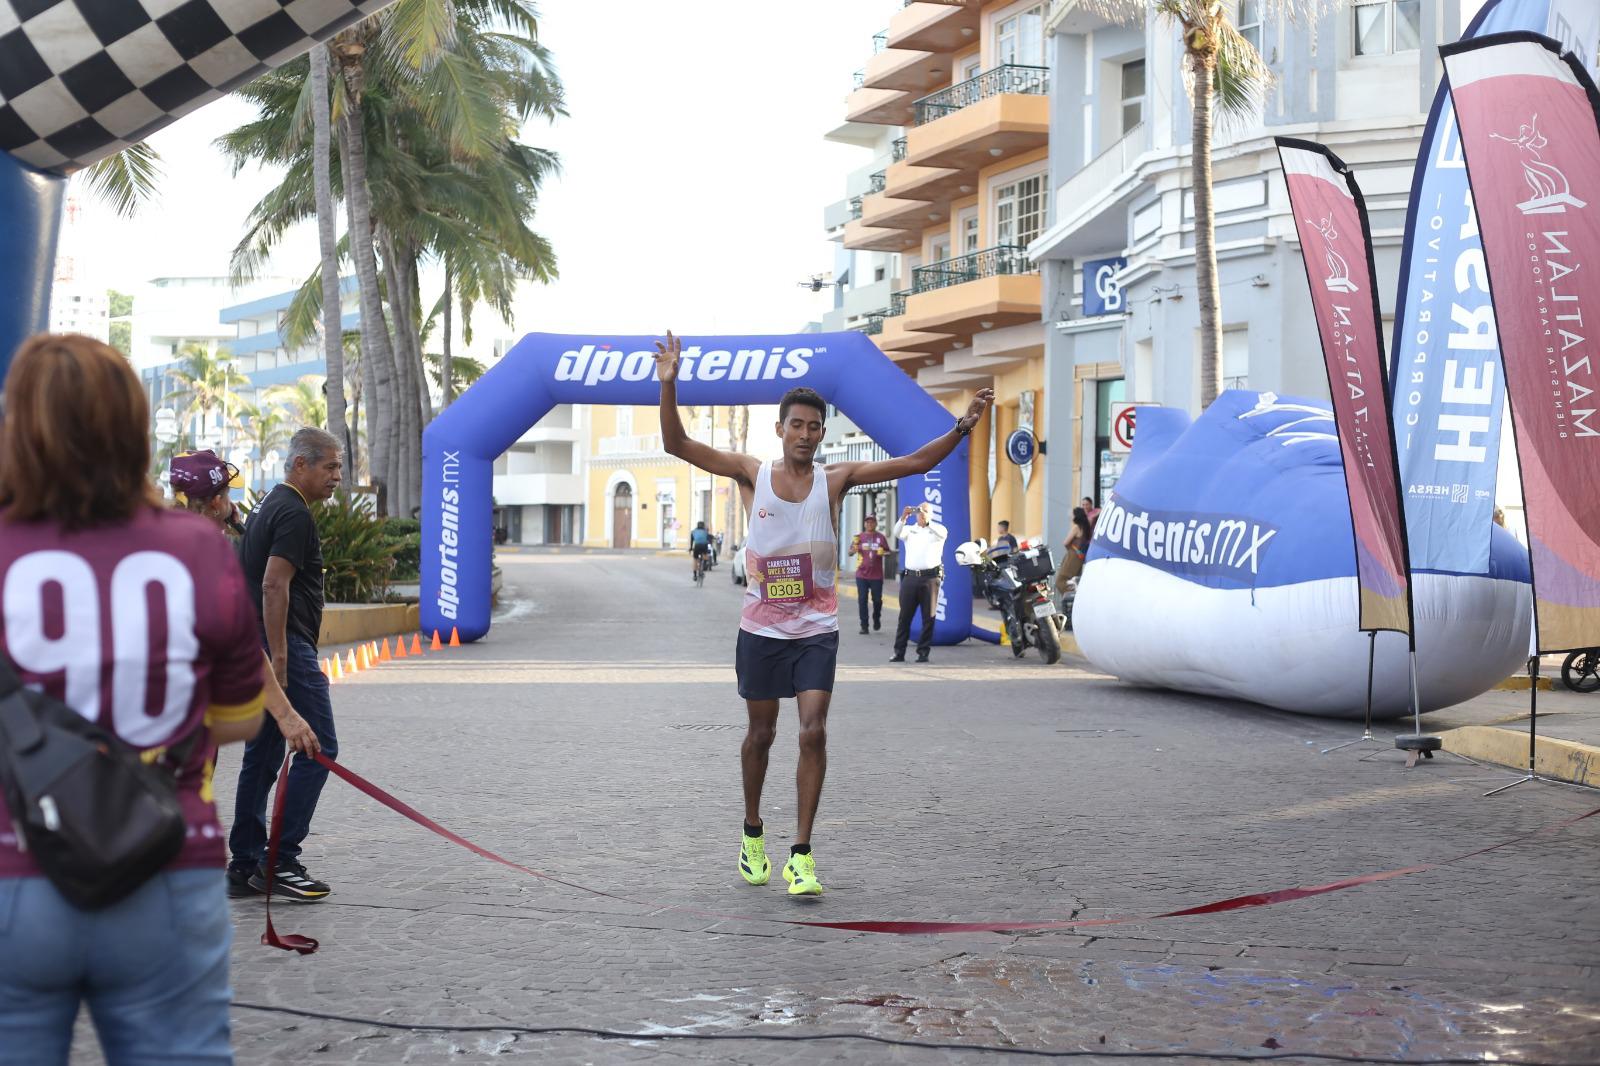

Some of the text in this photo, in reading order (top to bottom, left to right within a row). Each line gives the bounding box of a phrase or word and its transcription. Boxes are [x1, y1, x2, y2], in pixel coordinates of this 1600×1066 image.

[437, 450, 460, 620] dportenis.mx
[770, 584, 801, 596] 0303
[1093, 492, 1277, 574] portenis.mx
[3, 550, 200, 747] 90
